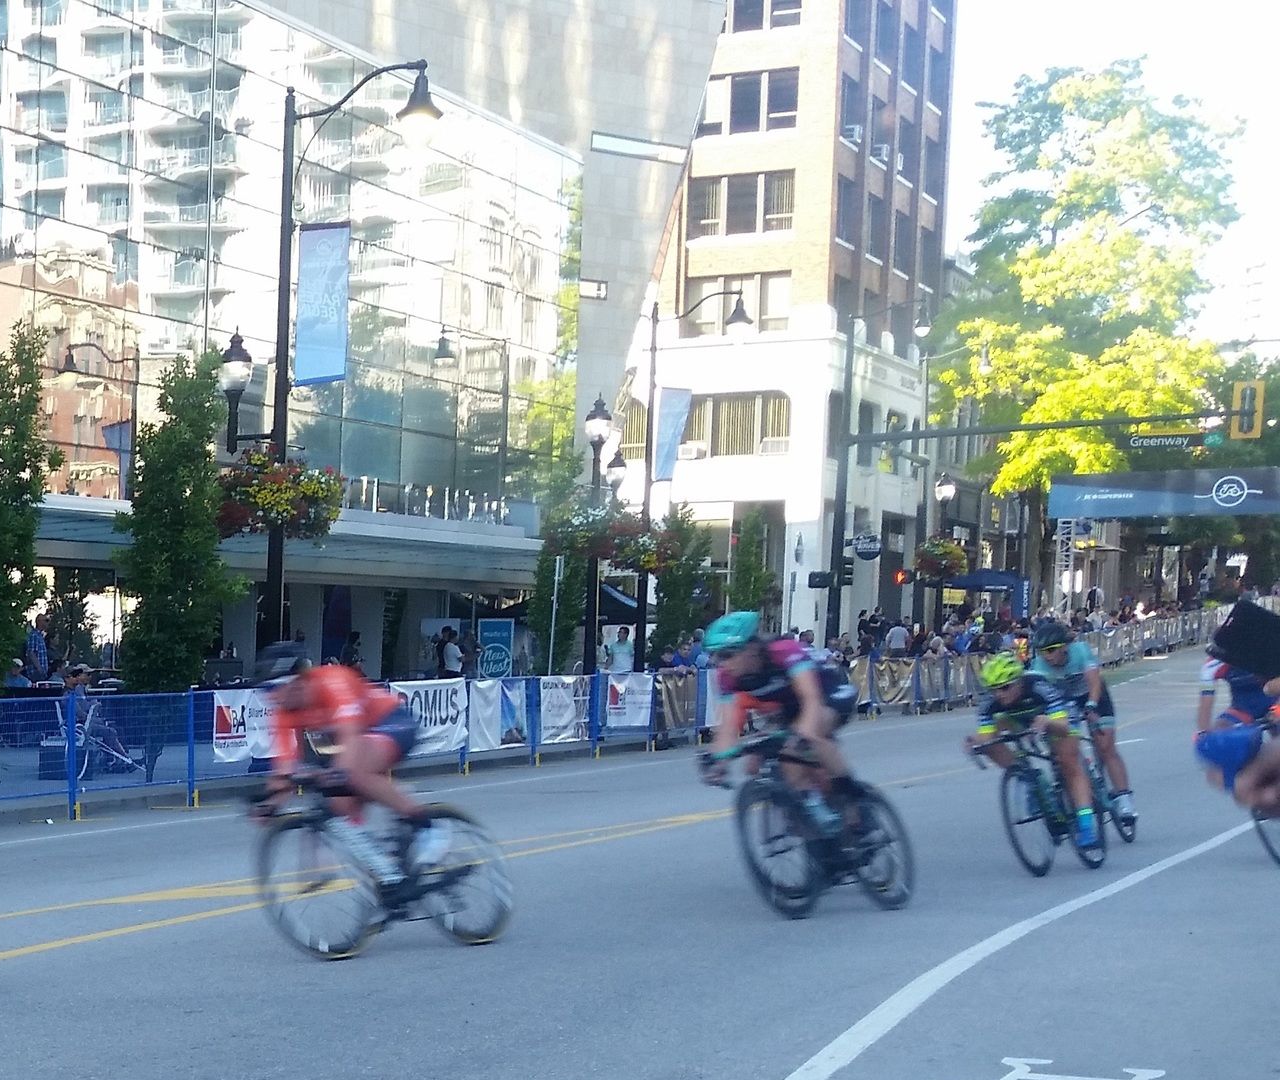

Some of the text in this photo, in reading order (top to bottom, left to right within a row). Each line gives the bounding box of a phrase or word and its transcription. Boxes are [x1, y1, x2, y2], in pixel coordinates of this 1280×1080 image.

[1130, 435, 1189, 447] Greenway
[483, 649, 506, 661] New
[482, 657, 511, 674] West
